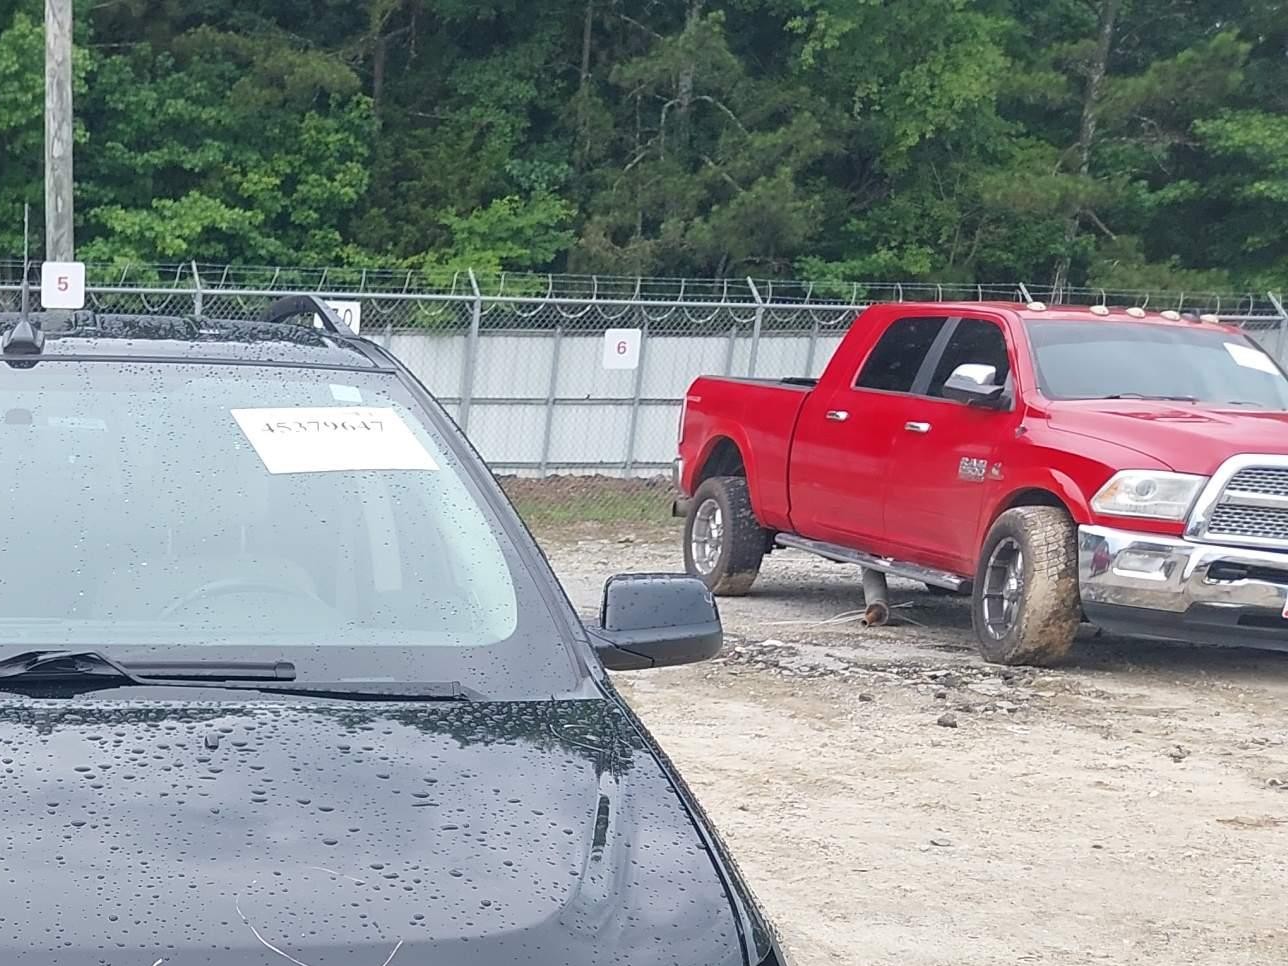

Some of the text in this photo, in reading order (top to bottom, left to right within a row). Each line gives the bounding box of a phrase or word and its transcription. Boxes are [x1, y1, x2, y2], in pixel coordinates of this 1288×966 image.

[57, 276, 69, 292] 5
[617, 340, 627, 355] 6
[261, 420, 385, 434] 45379647
